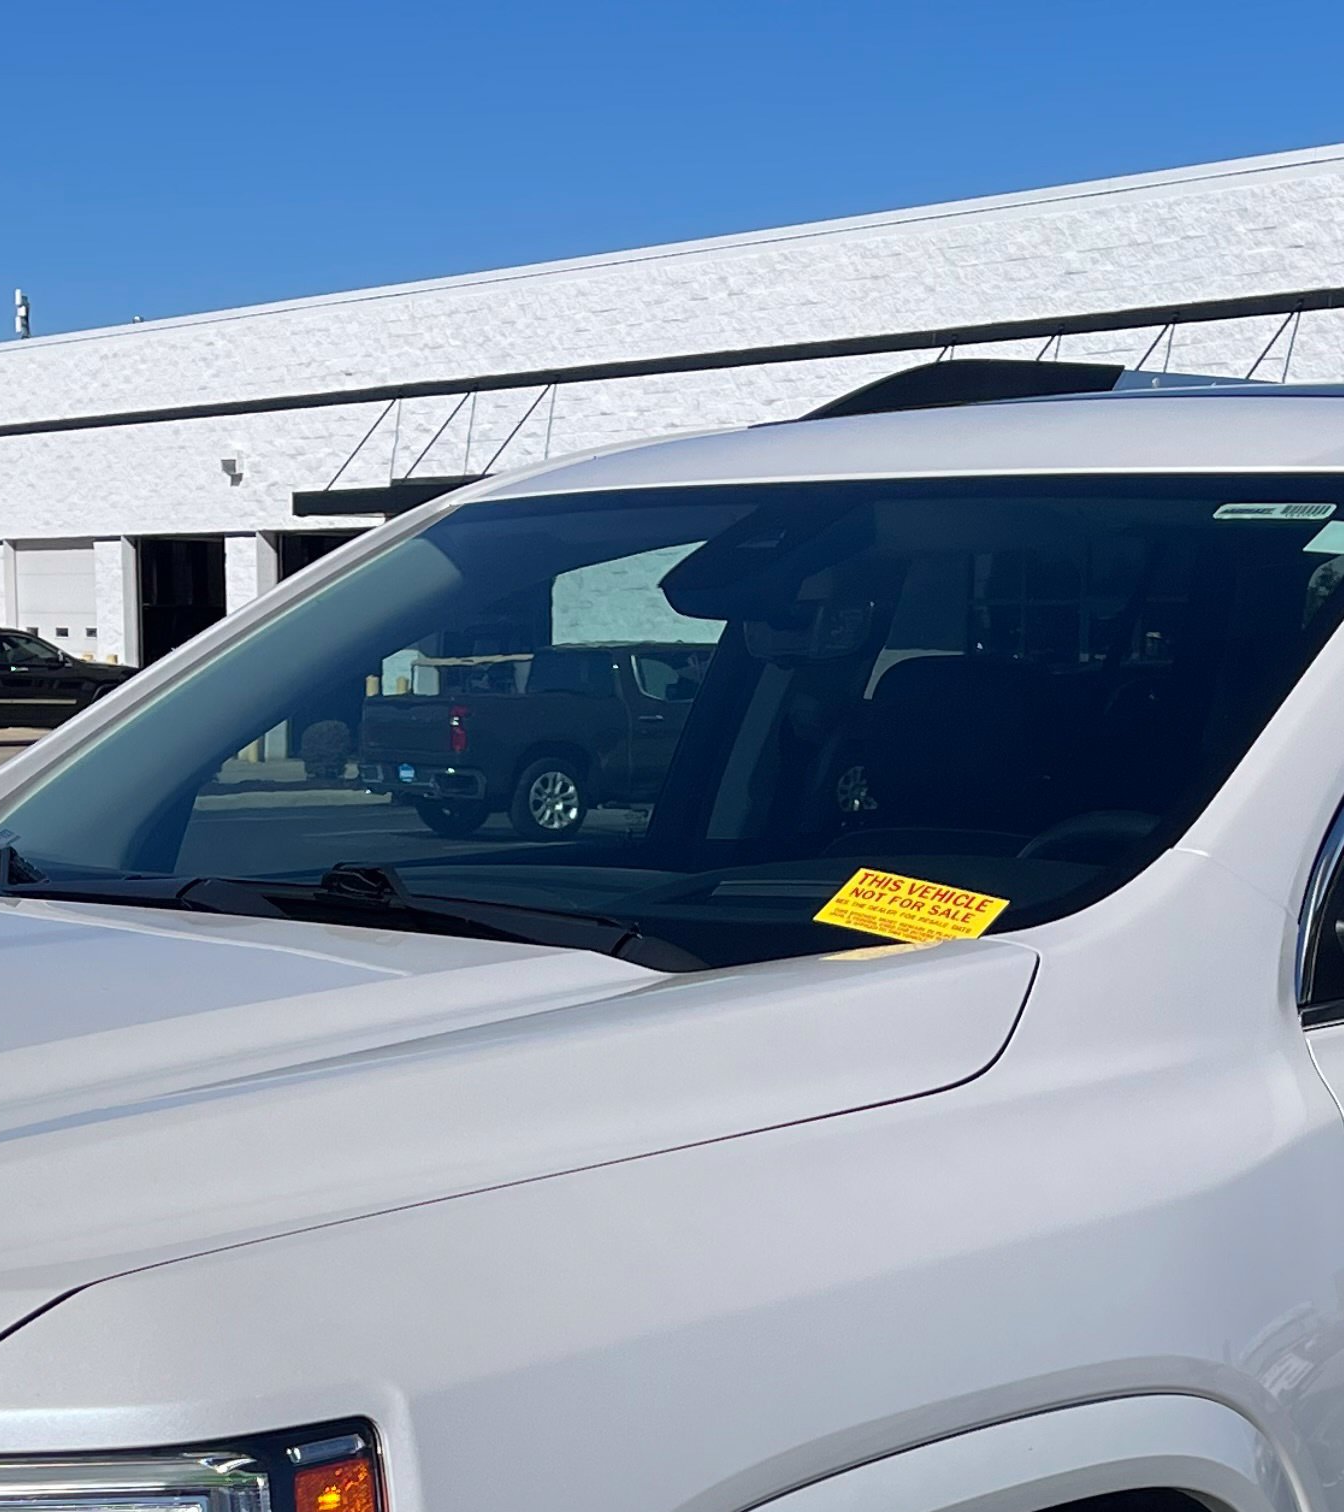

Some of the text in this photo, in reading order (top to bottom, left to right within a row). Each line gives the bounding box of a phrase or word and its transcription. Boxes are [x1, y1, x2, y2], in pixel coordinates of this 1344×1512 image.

[850, 886, 975, 923] NOT FOR SALE
[857, 872, 994, 913] THIS VEHICLE
